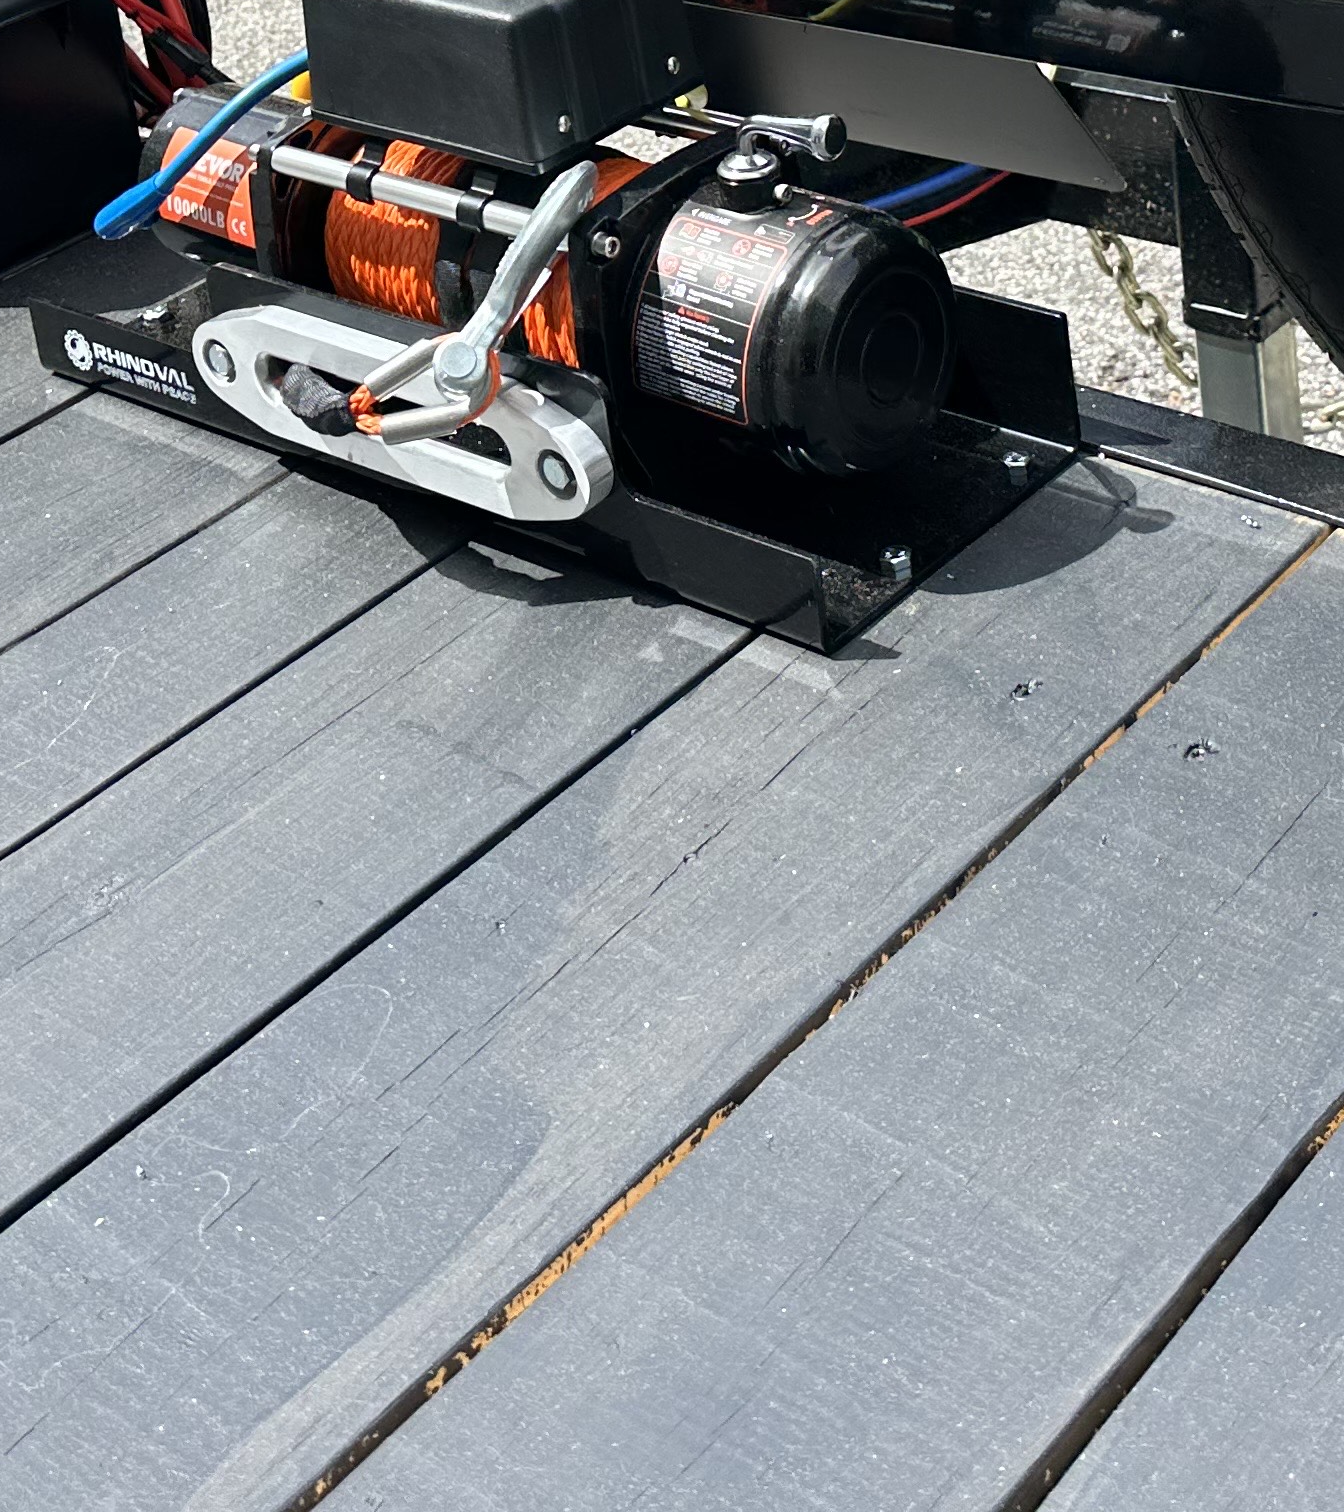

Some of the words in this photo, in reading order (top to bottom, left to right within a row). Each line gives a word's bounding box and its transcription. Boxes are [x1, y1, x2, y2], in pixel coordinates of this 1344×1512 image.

[193, 152, 245, 183] EVOR
[92, 341, 196, 392] RHINOVAL
[97, 361, 135, 384] POWER
[134, 373, 162, 394] WITH
[162, 381, 198, 405] PEACE
